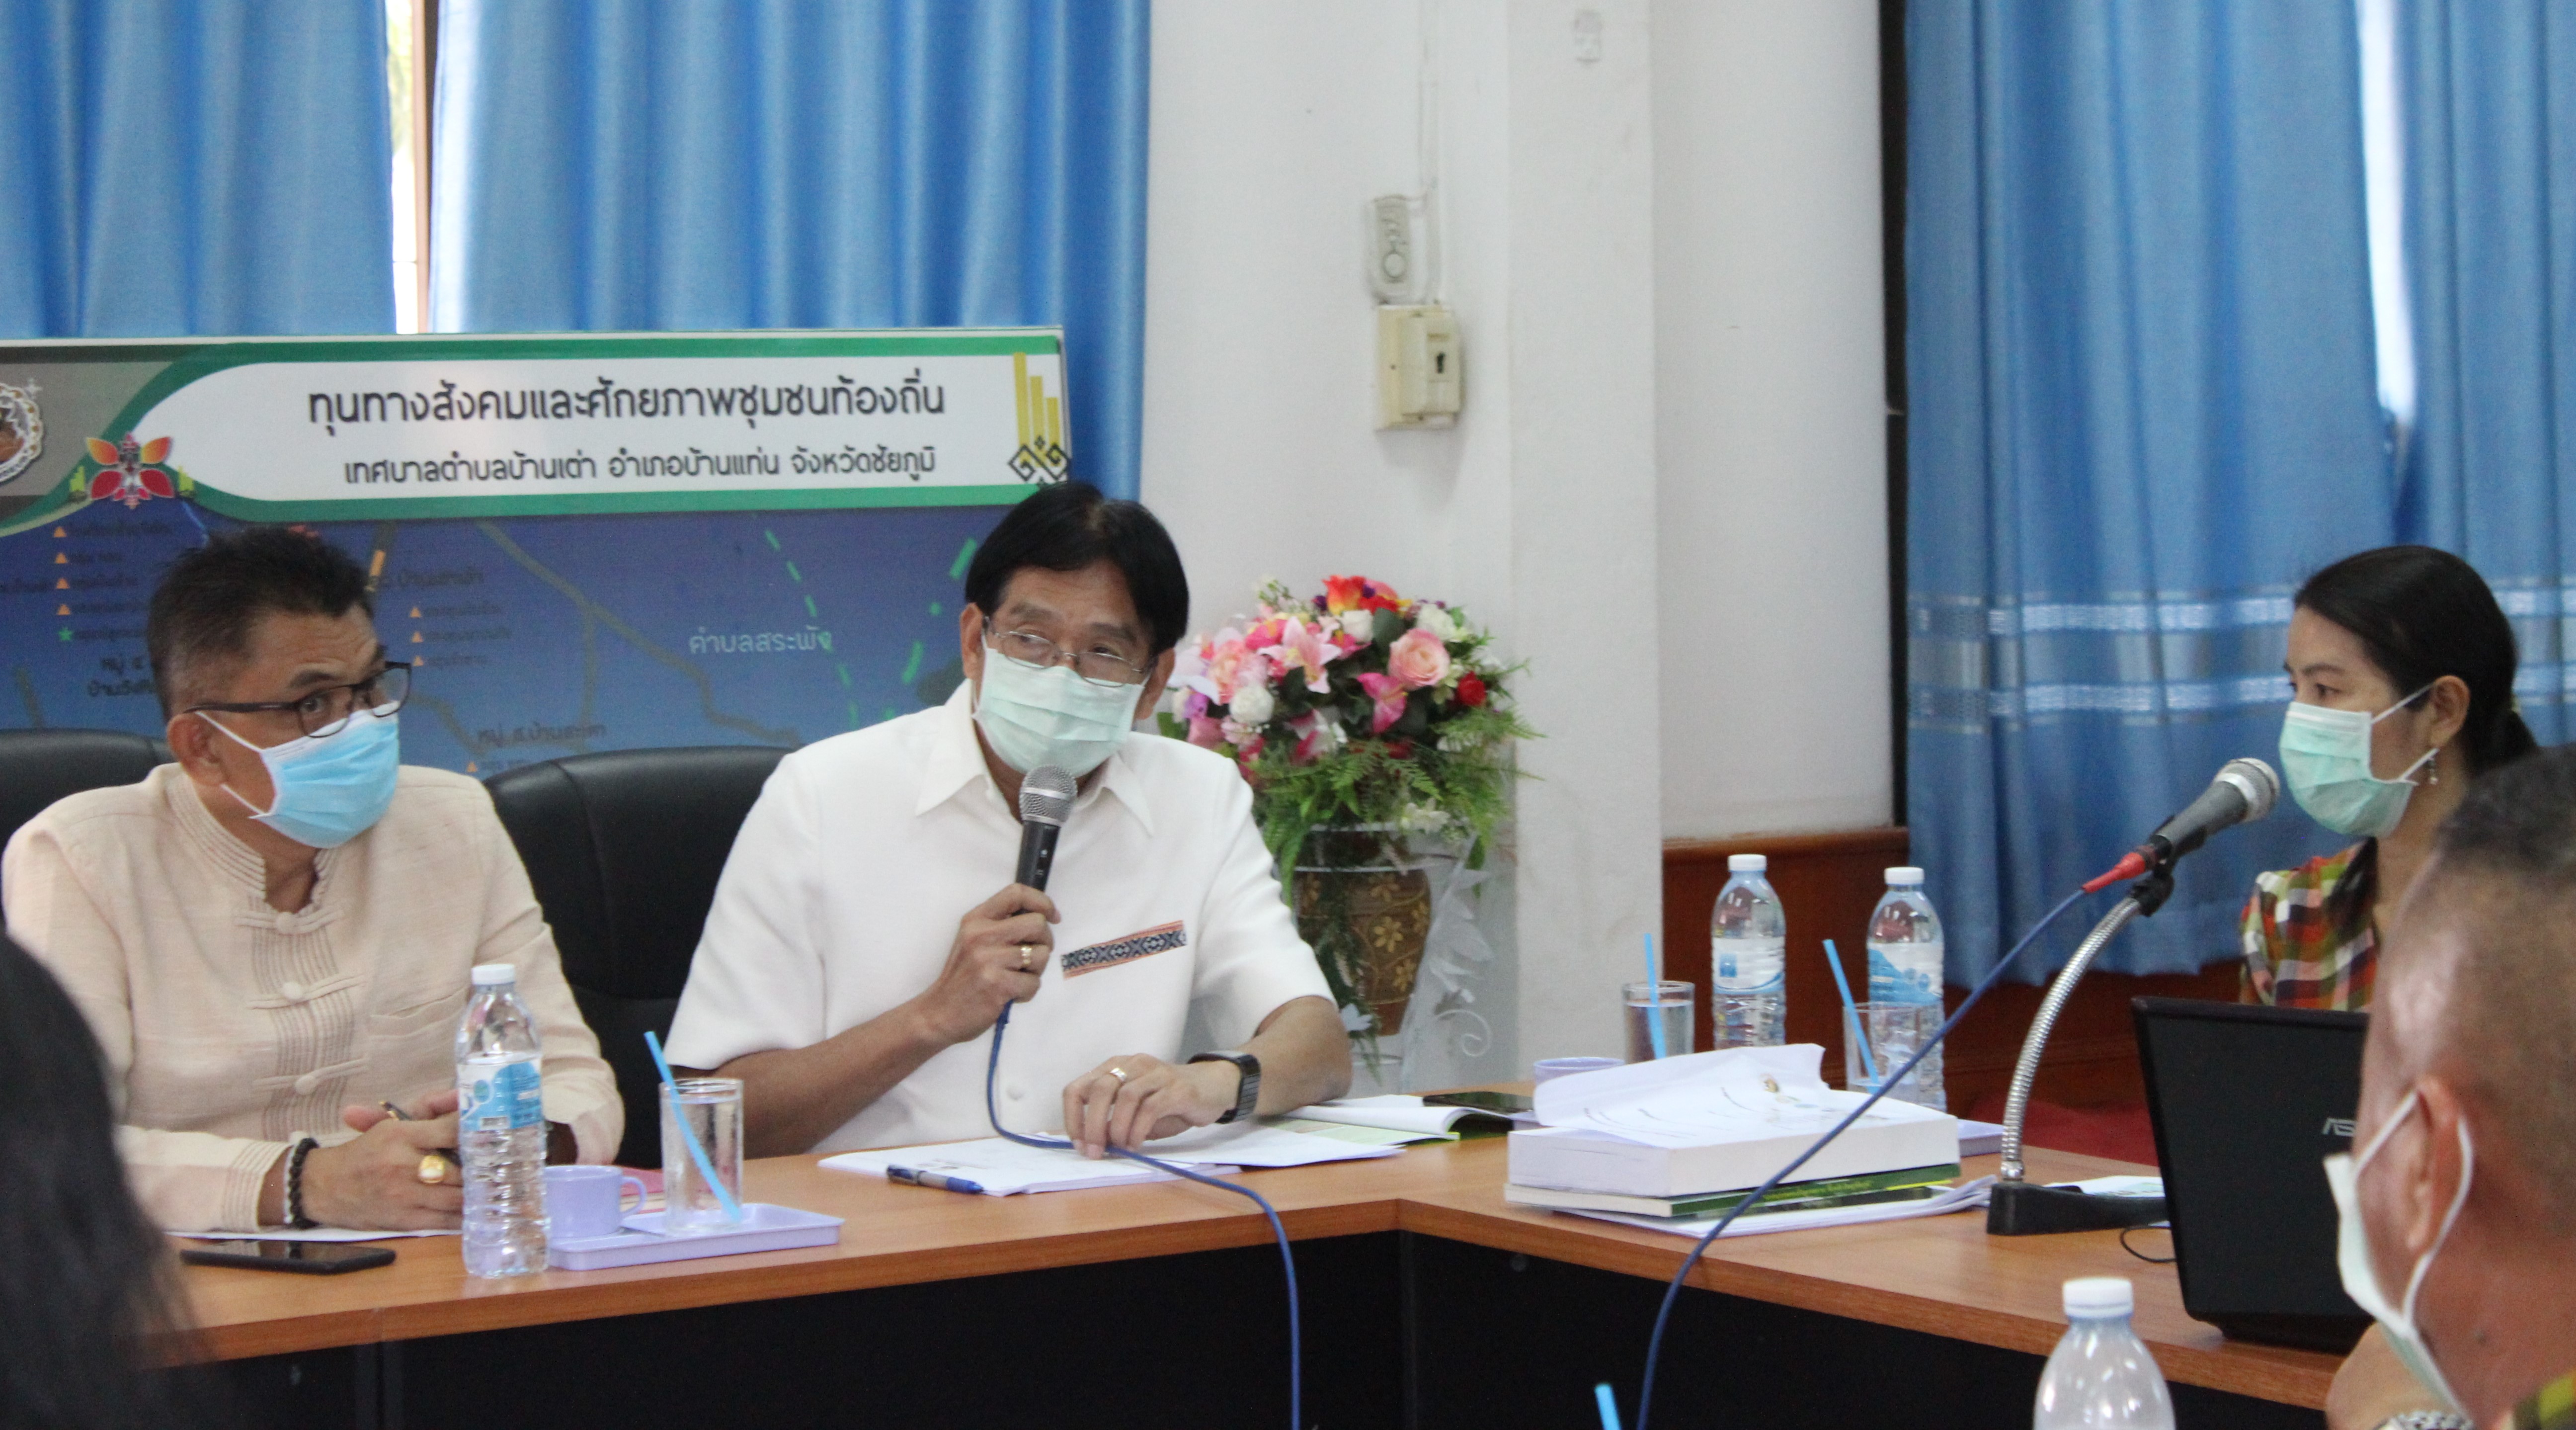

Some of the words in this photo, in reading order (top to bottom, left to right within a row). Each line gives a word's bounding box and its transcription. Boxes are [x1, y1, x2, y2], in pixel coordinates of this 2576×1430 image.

[308, 368, 945, 436] ทุนทางสังคมและศักยภาพชุมชนท้องถิ่น
[345, 449, 598, 484] เทศบาลตำบลบ้านเต่า
[608, 447, 780, 478] อำเภอบ้านแท่น
[791, 444, 936, 481] จังหวัดชัยภูมิ
[2322, 1117, 2356, 1138] AS
